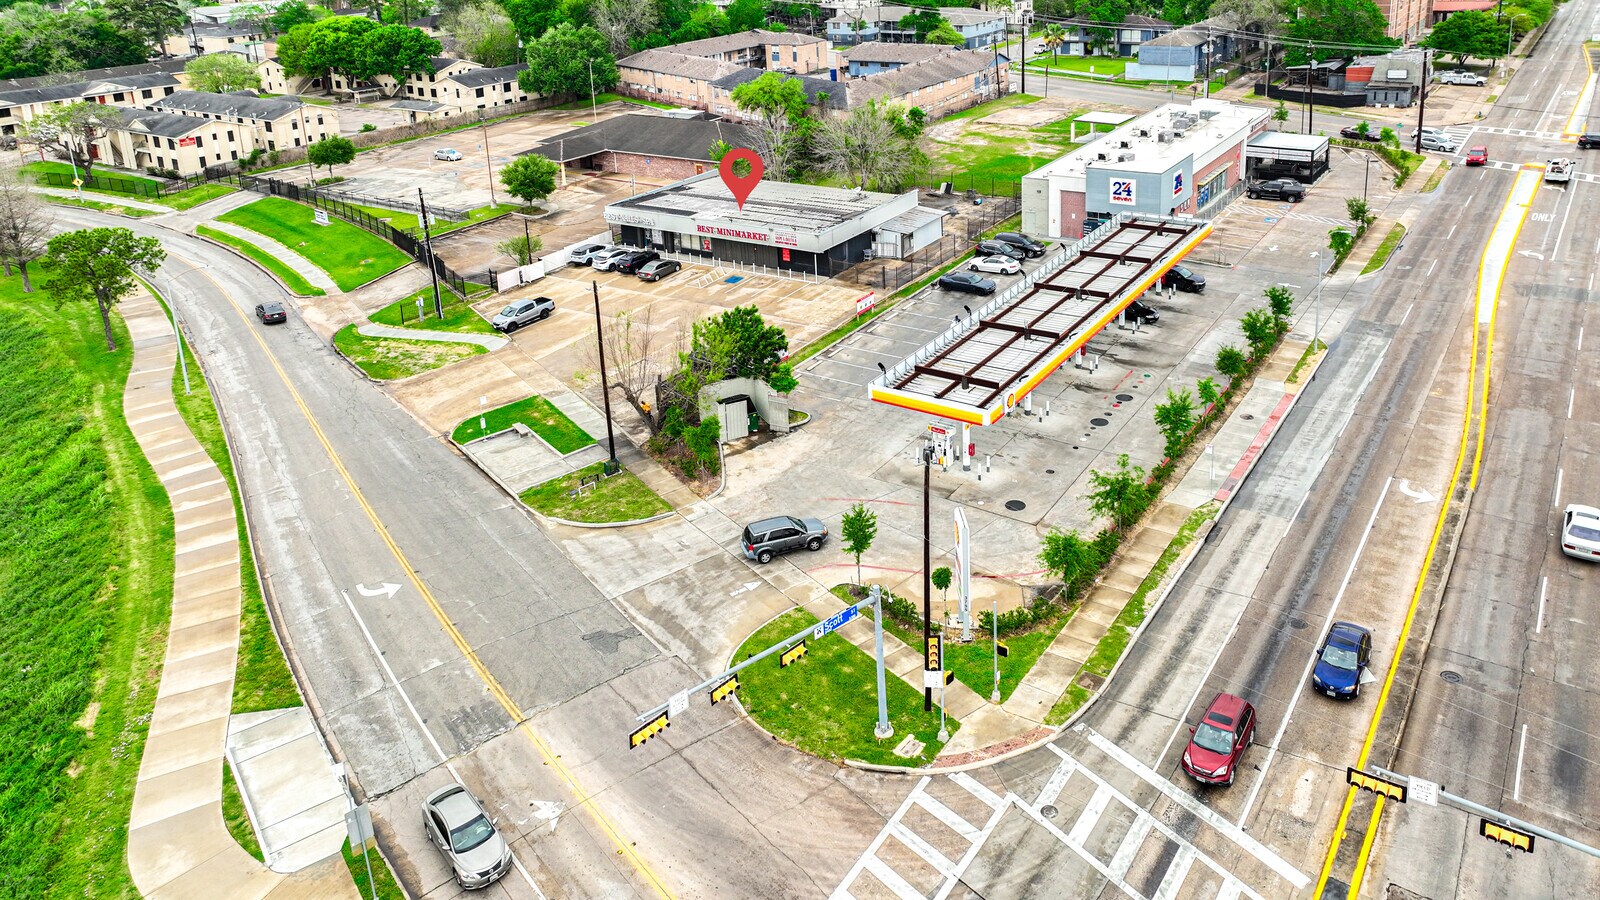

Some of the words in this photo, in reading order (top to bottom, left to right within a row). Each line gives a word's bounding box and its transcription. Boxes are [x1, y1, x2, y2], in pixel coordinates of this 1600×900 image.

[1531, 212, 1556, 222] ONLY
[697, 225, 714, 234] BEST
[716, 227, 768, 242] MINIMARKET
[825, 613, 843, 631] Scott
